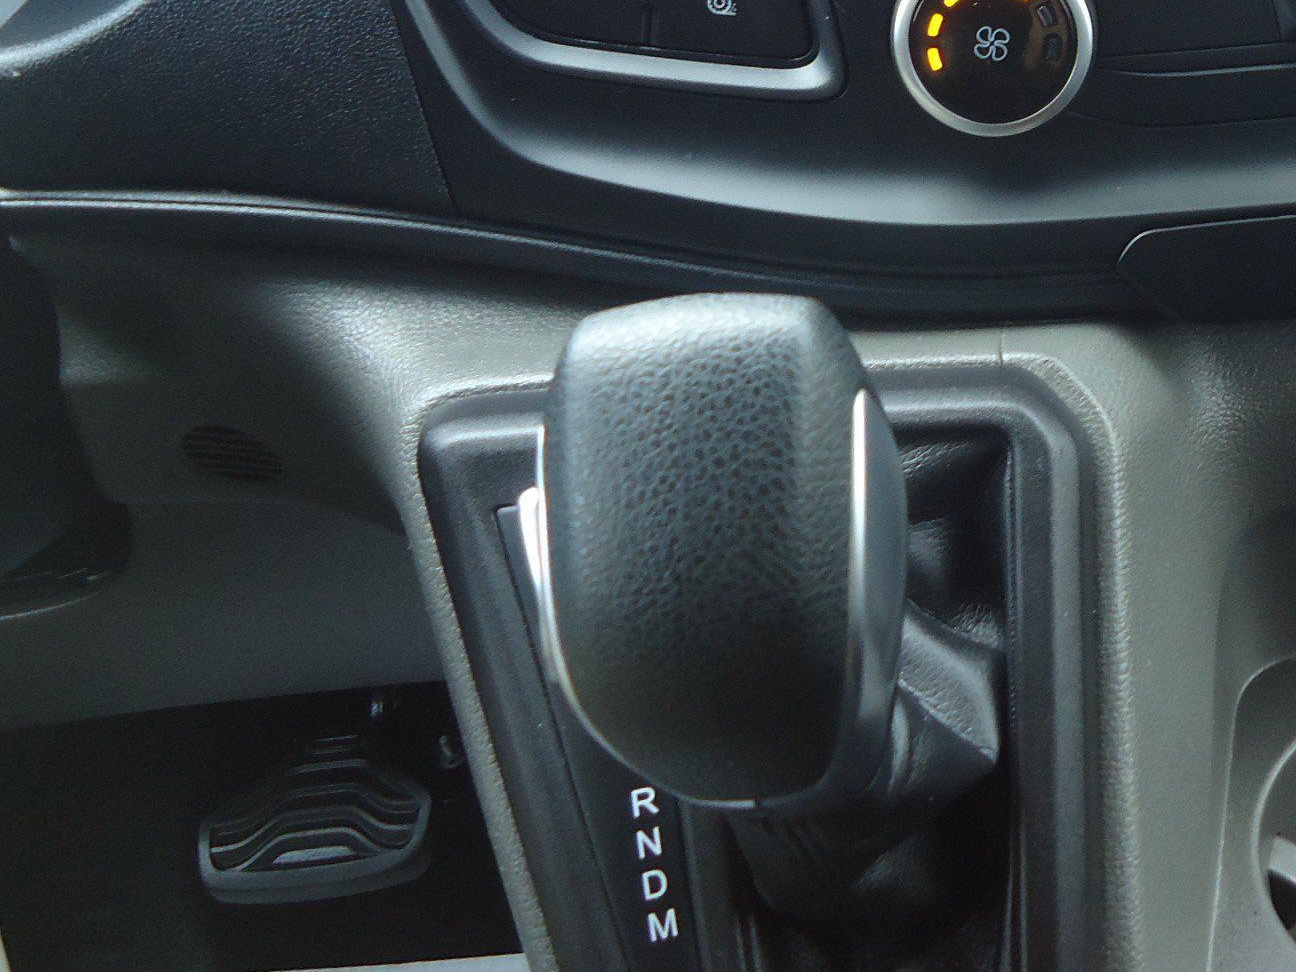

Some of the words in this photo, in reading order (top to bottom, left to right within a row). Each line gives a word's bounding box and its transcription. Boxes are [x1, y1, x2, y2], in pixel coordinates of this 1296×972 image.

[630, 786, 660, 819] R
[635, 825, 663, 860] N
[641, 869, 668, 902] D
[647, 908, 679, 943] M
